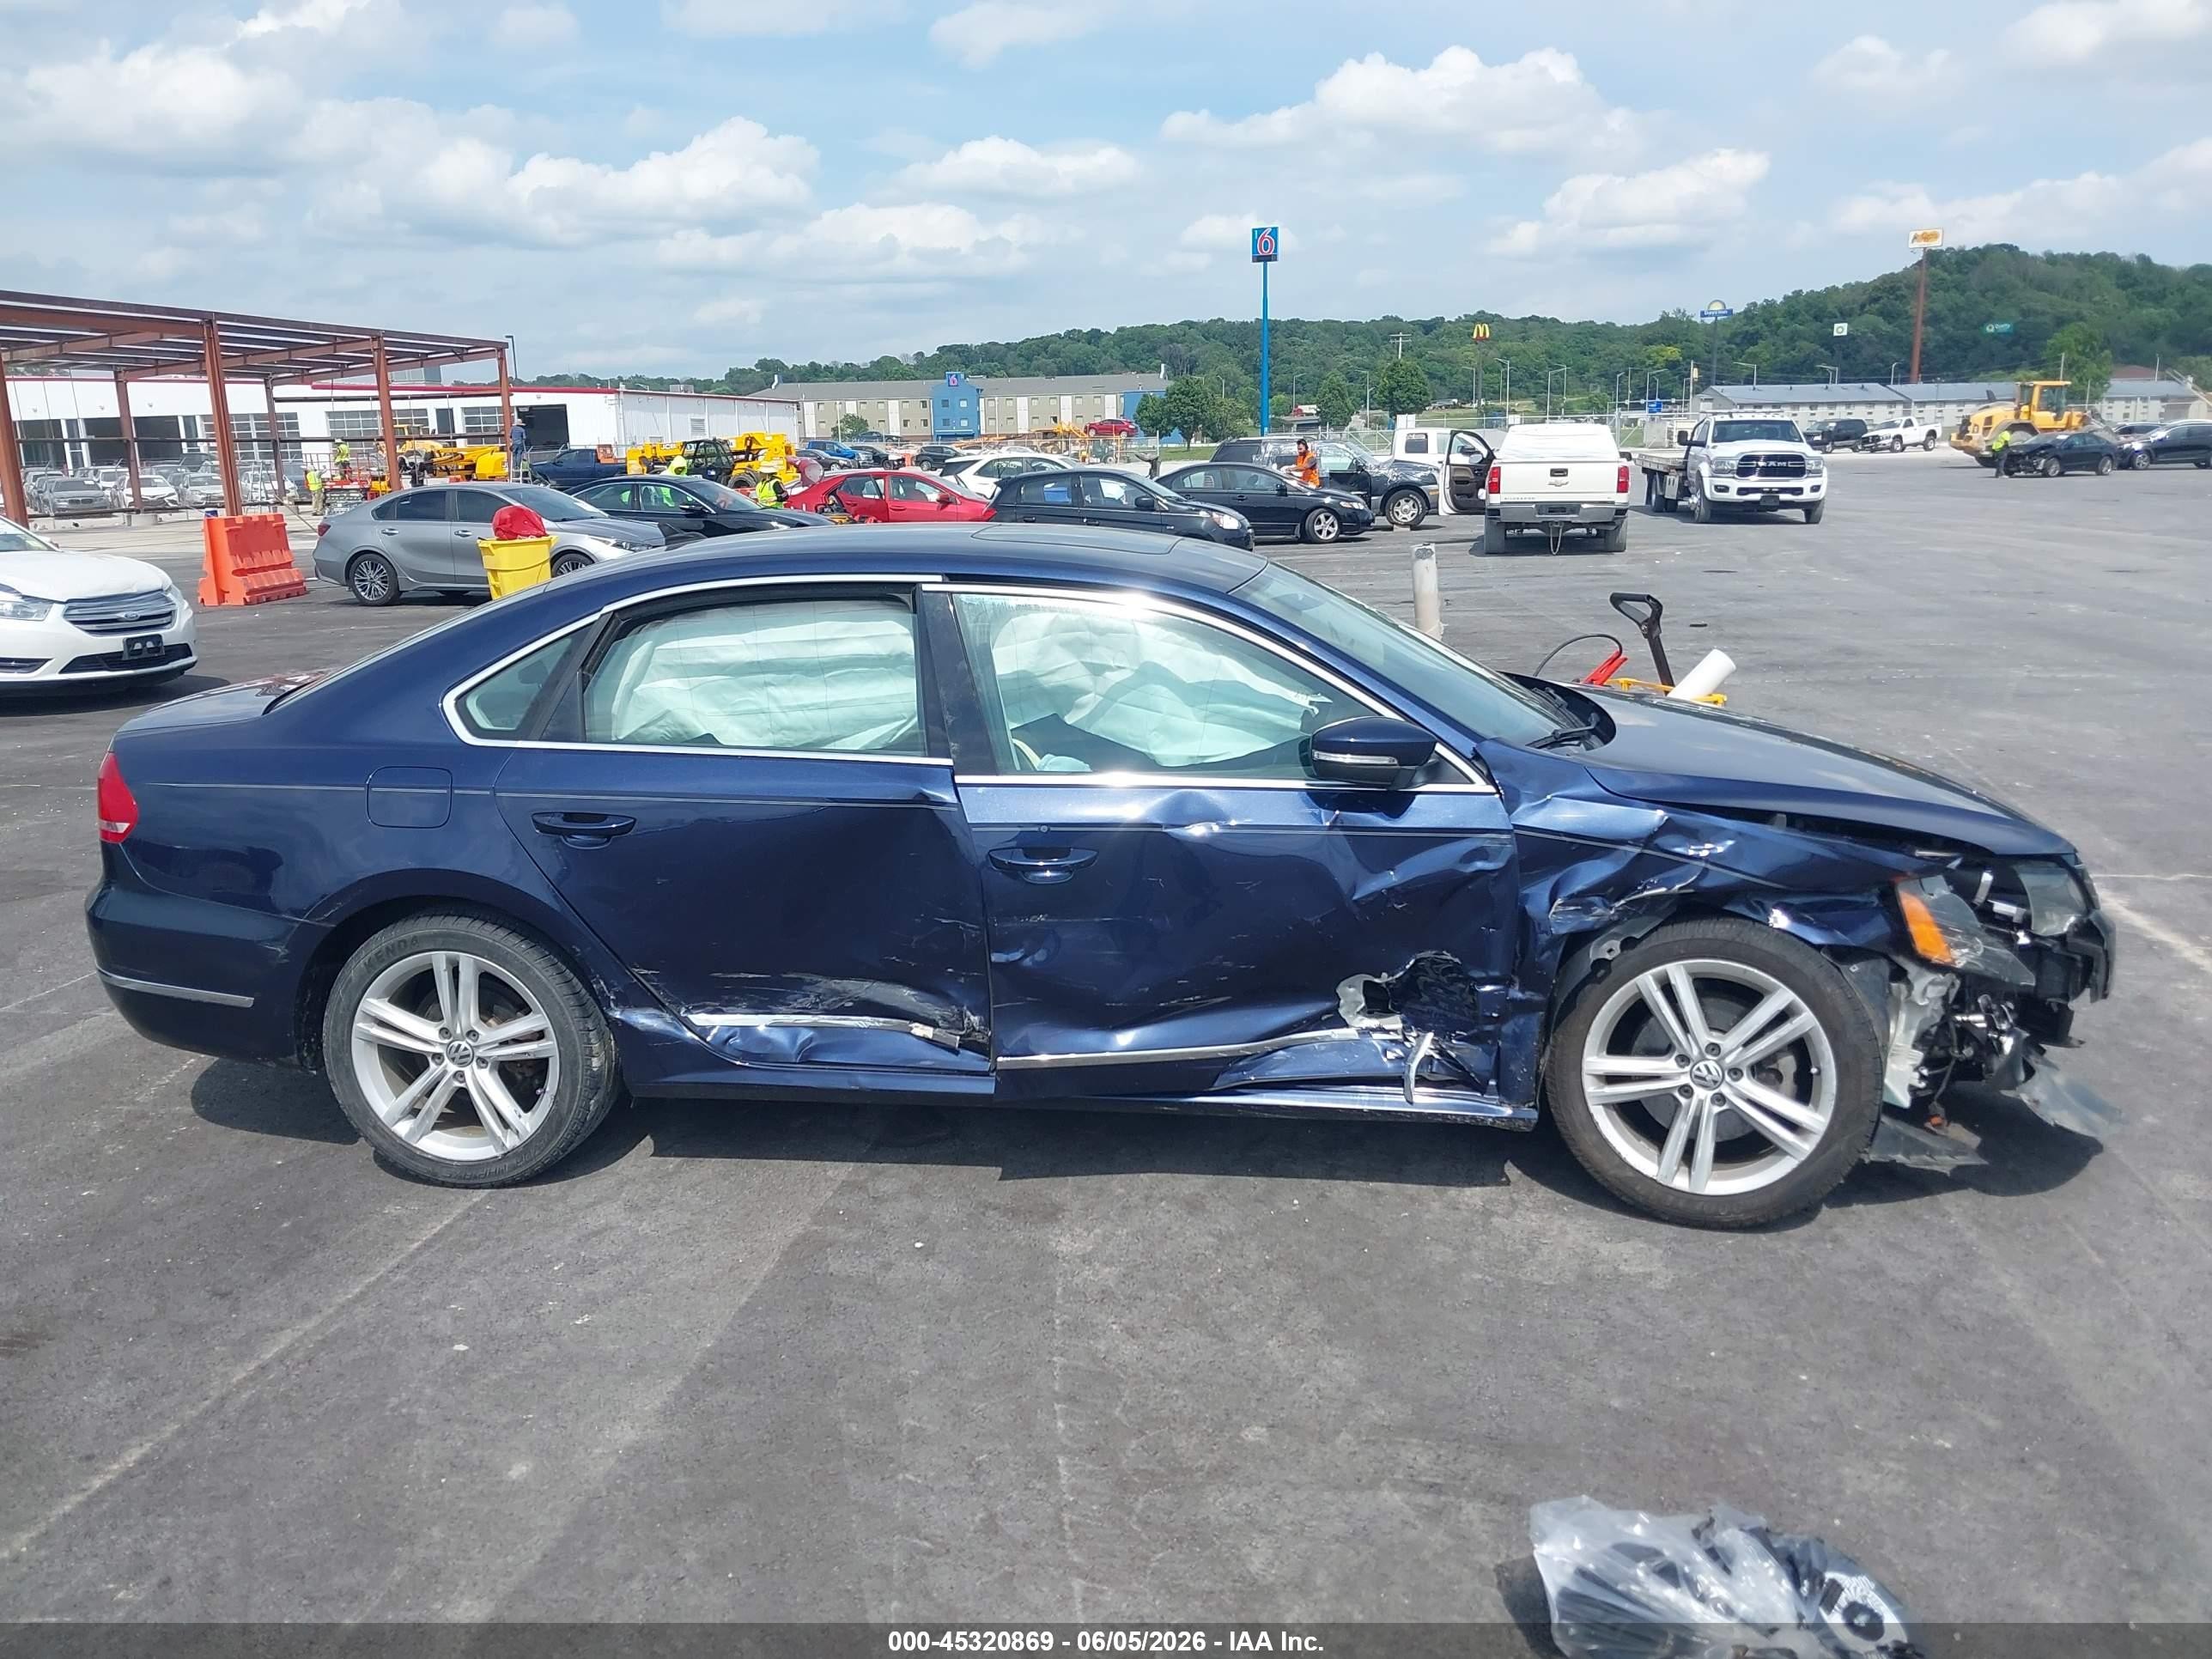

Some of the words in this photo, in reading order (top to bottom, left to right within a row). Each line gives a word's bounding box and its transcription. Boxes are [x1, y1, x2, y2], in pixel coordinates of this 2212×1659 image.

[1257, 228, 1275, 255] 6
[949, 374, 958, 386] 6
[363, 935, 420, 974] KENDA
